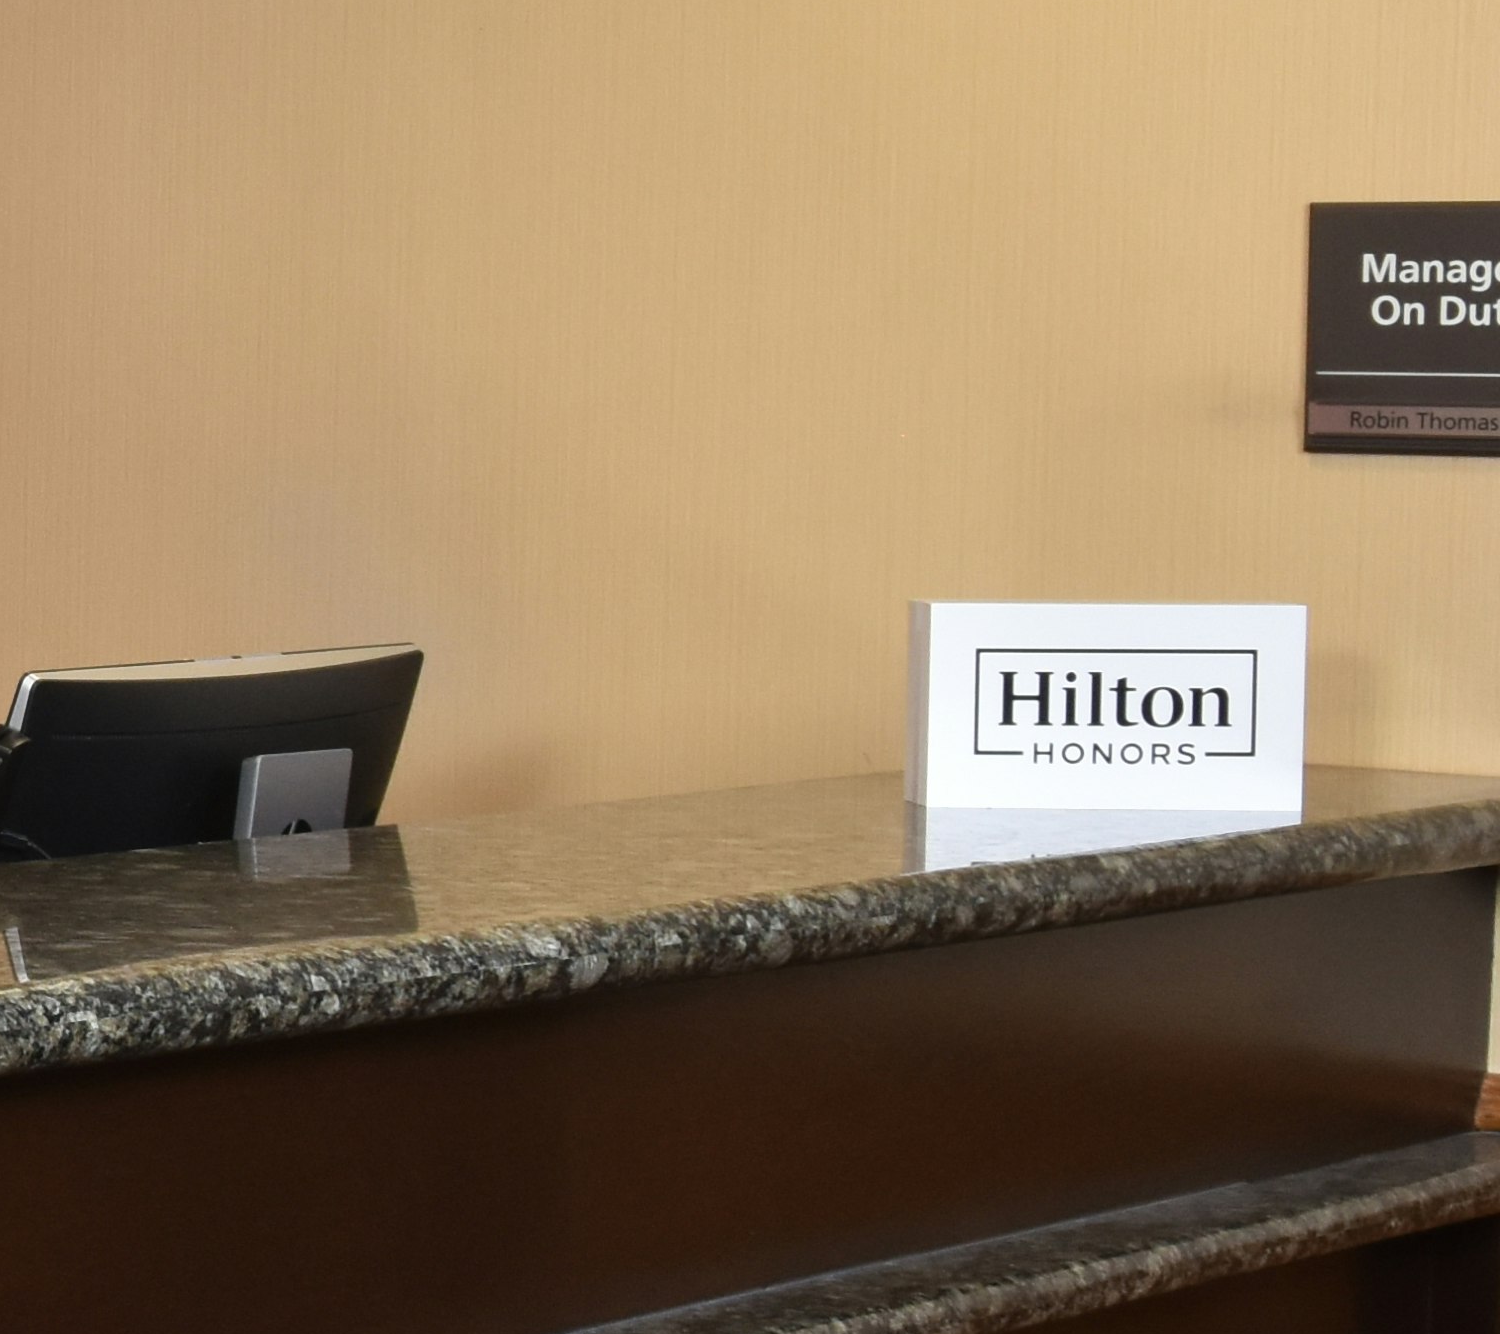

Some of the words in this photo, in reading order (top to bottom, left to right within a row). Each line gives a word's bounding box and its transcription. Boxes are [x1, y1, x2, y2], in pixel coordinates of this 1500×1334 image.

[1371, 295, 1426, 326] On
[1350, 410, 1409, 429] Robin
[1416, 412, 1499, 431] Thomas
[998, 671, 1232, 728] Hilton
[1033, 743, 1196, 765] HONORS
